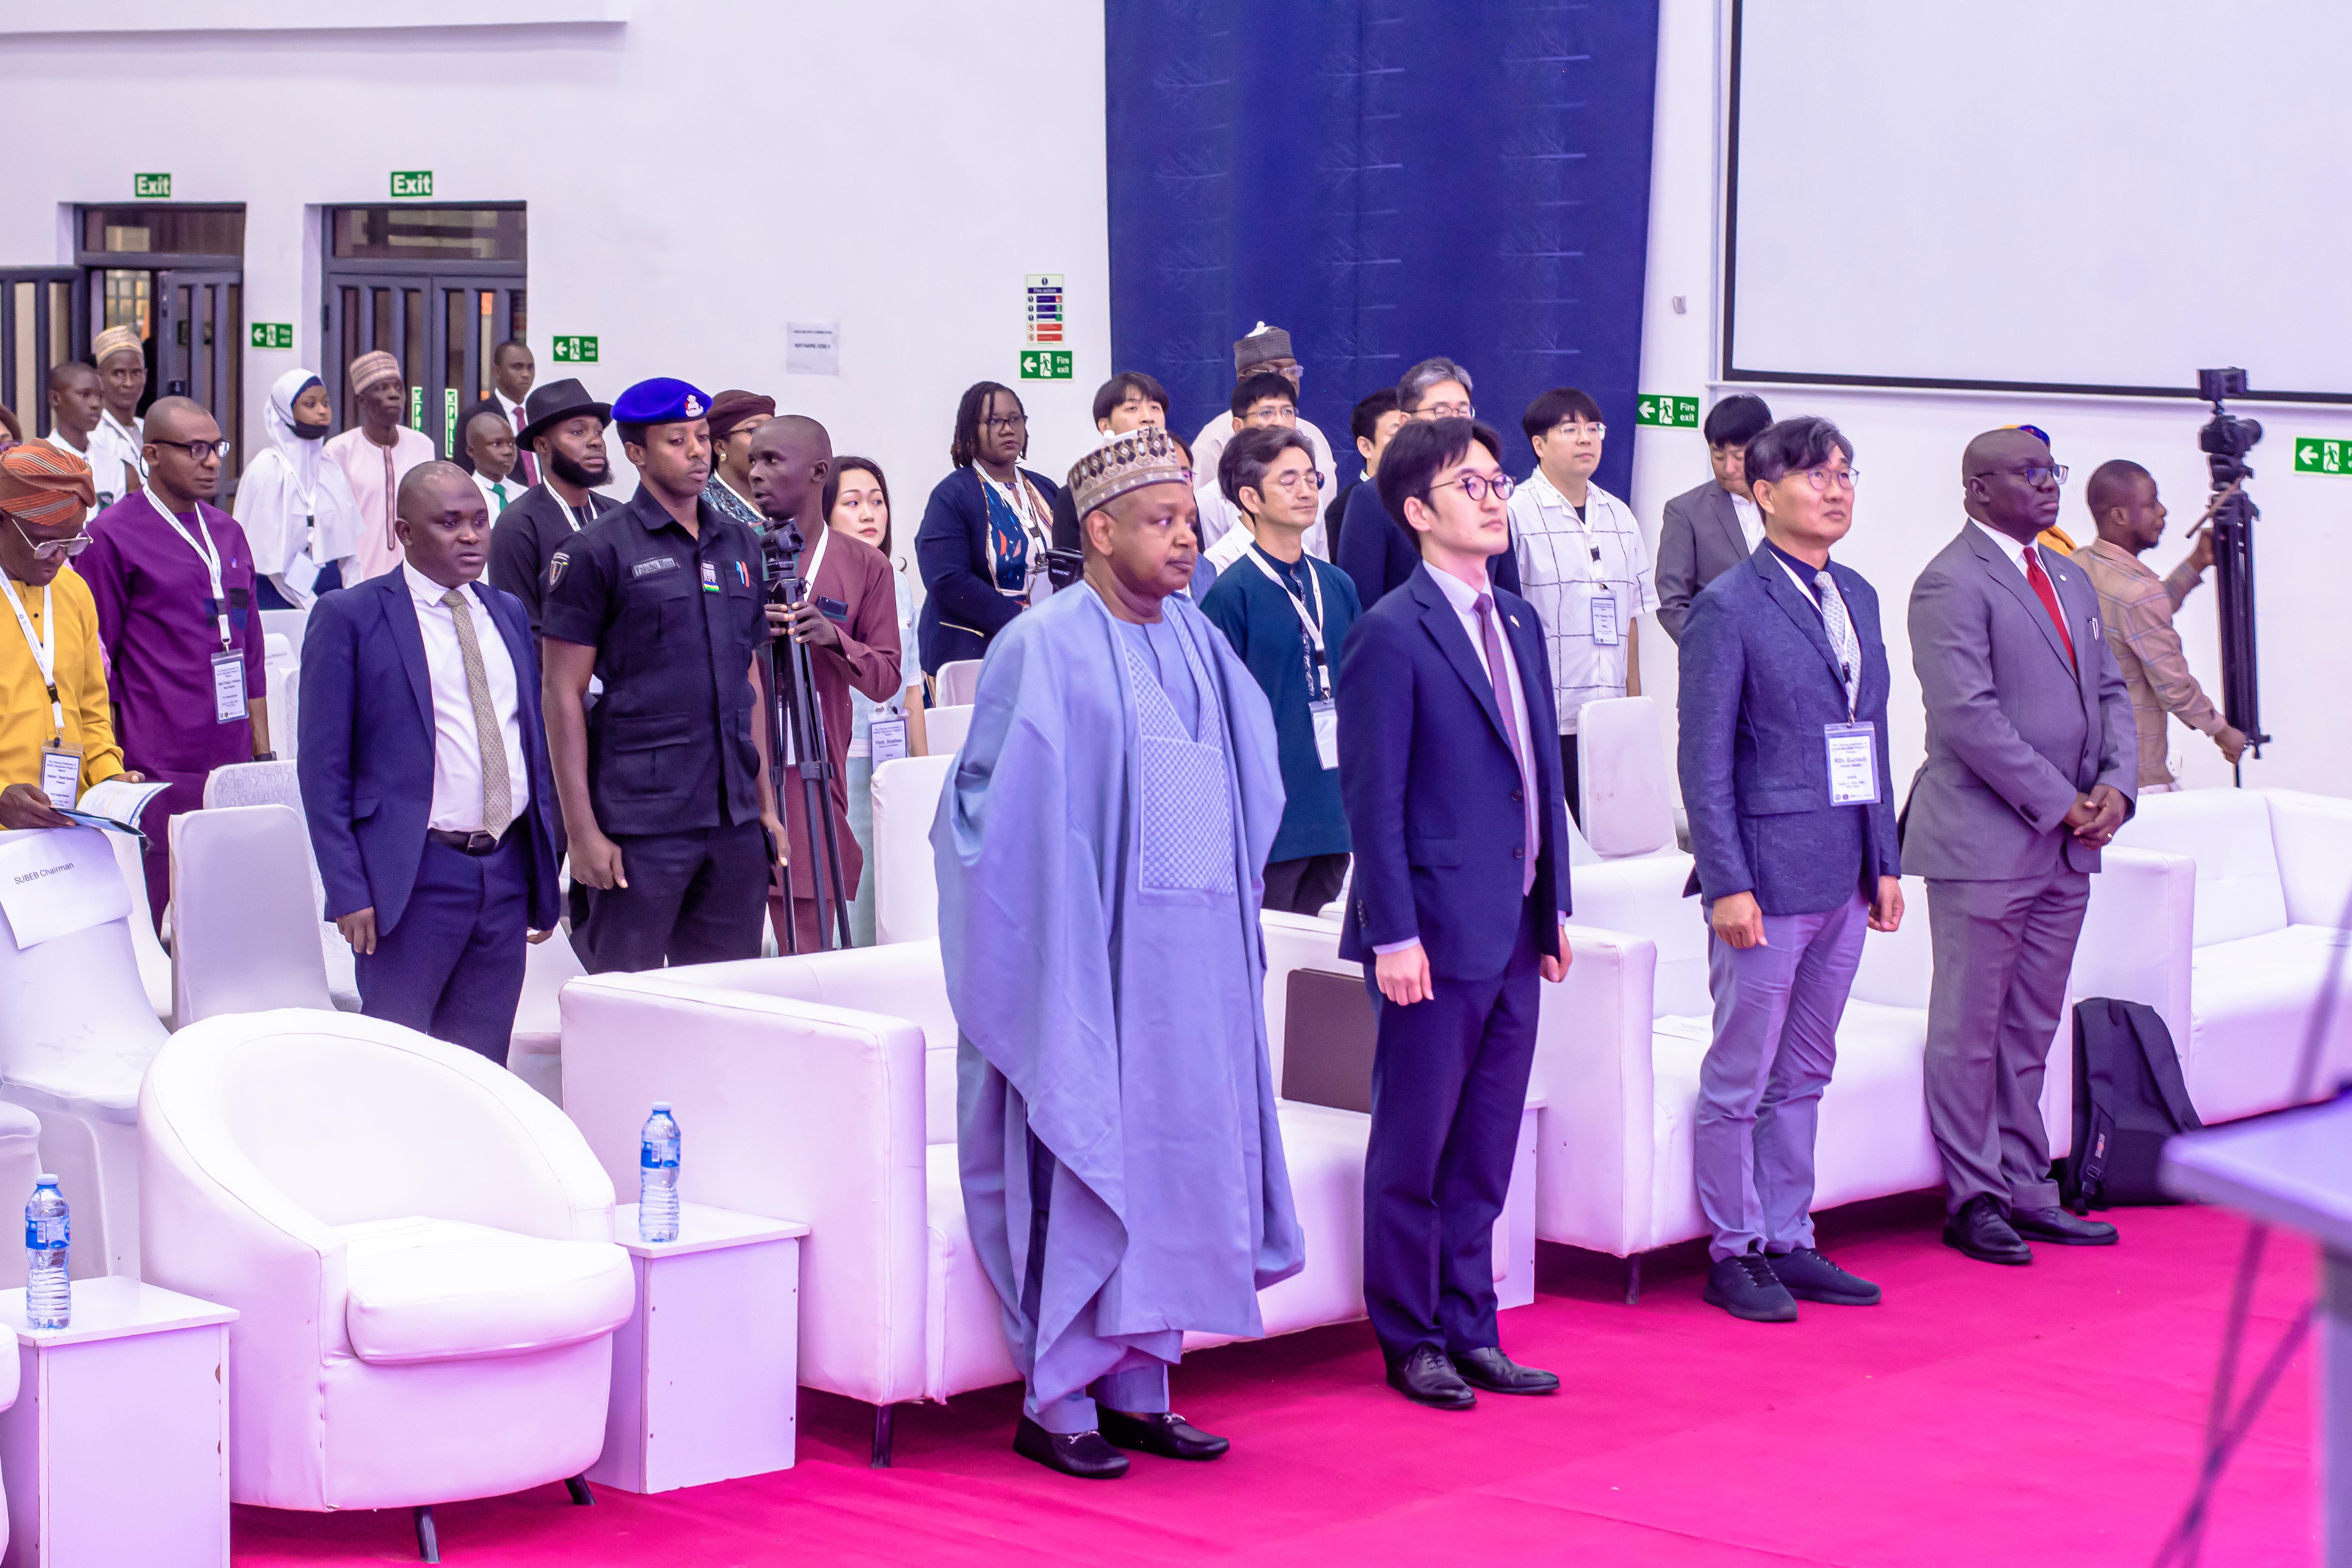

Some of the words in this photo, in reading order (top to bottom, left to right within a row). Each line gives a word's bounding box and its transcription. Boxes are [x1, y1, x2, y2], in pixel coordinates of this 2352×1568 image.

[137, 176, 169, 194] Exit
[393, 174, 431, 194] Exit
[1056, 356, 1069, 364] Fire
[1680, 402, 1695, 412] Fire
[1680, 413, 1695, 422] exit
[14, 872, 39, 884] SUBEB
[40, 863, 74, 877] Chairman
